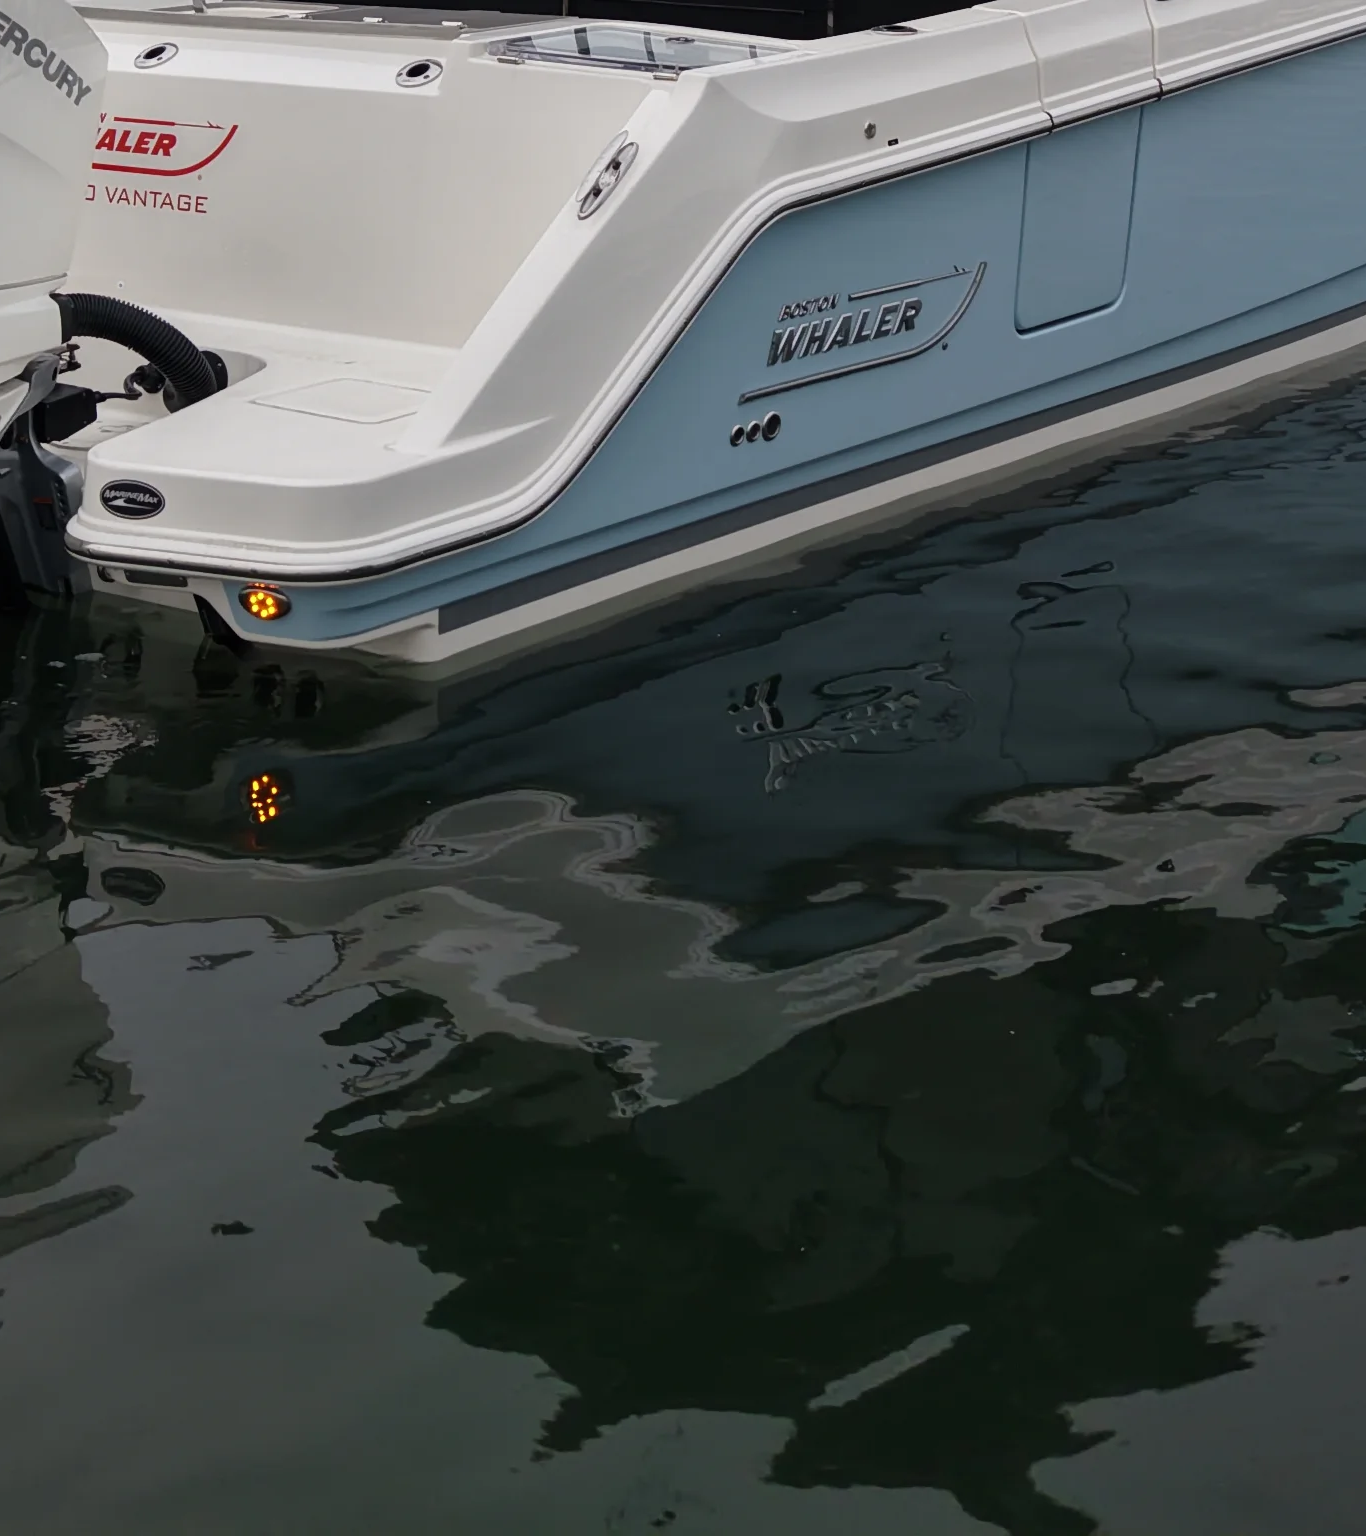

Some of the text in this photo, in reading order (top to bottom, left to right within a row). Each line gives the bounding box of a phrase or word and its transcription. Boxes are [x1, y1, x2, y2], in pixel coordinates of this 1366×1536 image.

[95, 128, 177, 157] ALER
[105, 186, 209, 214] VANTAGE
[777, 293, 840, 322] BOSTON
[766, 297, 923, 367] WHALER
